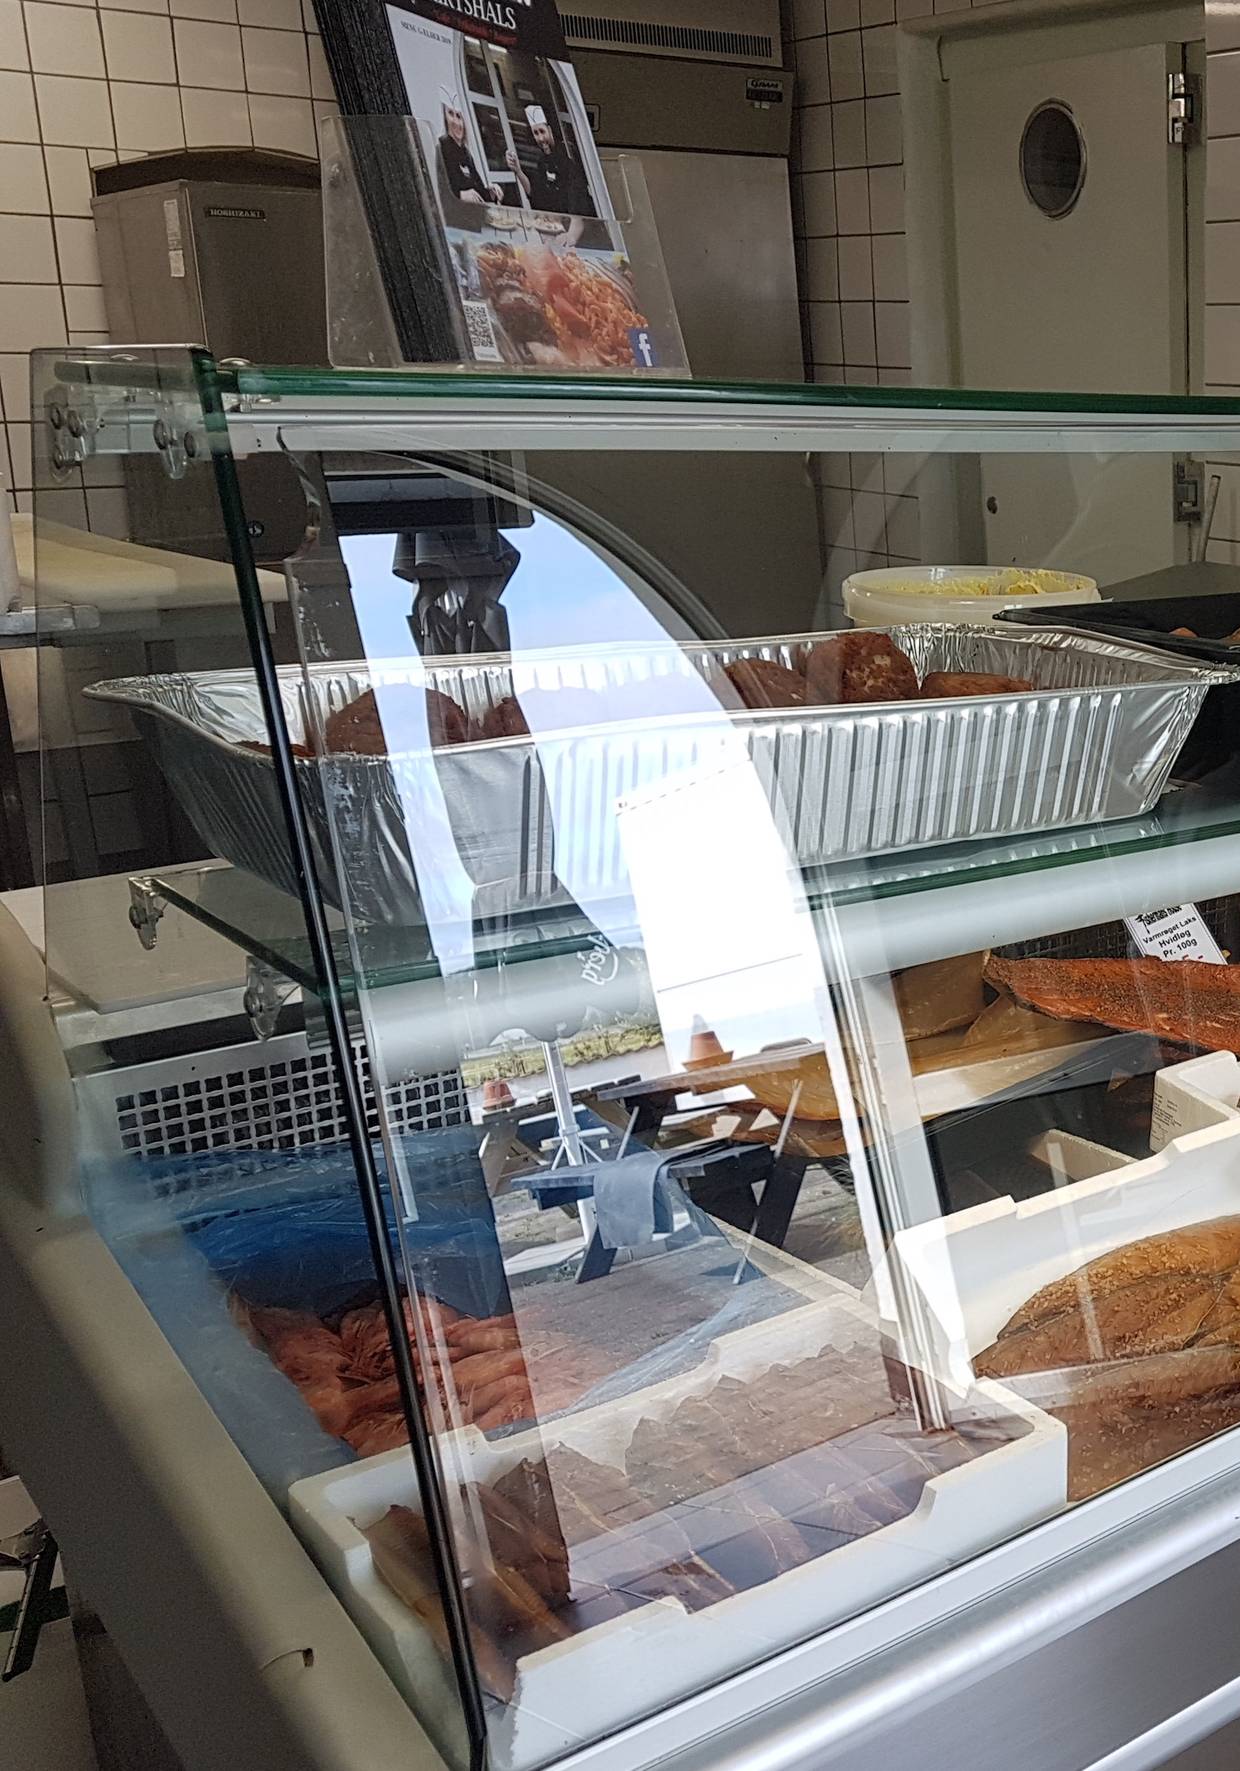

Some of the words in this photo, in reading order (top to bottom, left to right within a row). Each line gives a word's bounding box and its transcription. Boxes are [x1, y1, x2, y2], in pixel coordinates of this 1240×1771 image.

[1180, 916, 1197, 928] Laks
[1158, 929, 1192, 948] Hvidløg
[1163, 949, 1177, 958] Pr.
[1177, 938, 1198, 951] 100g
